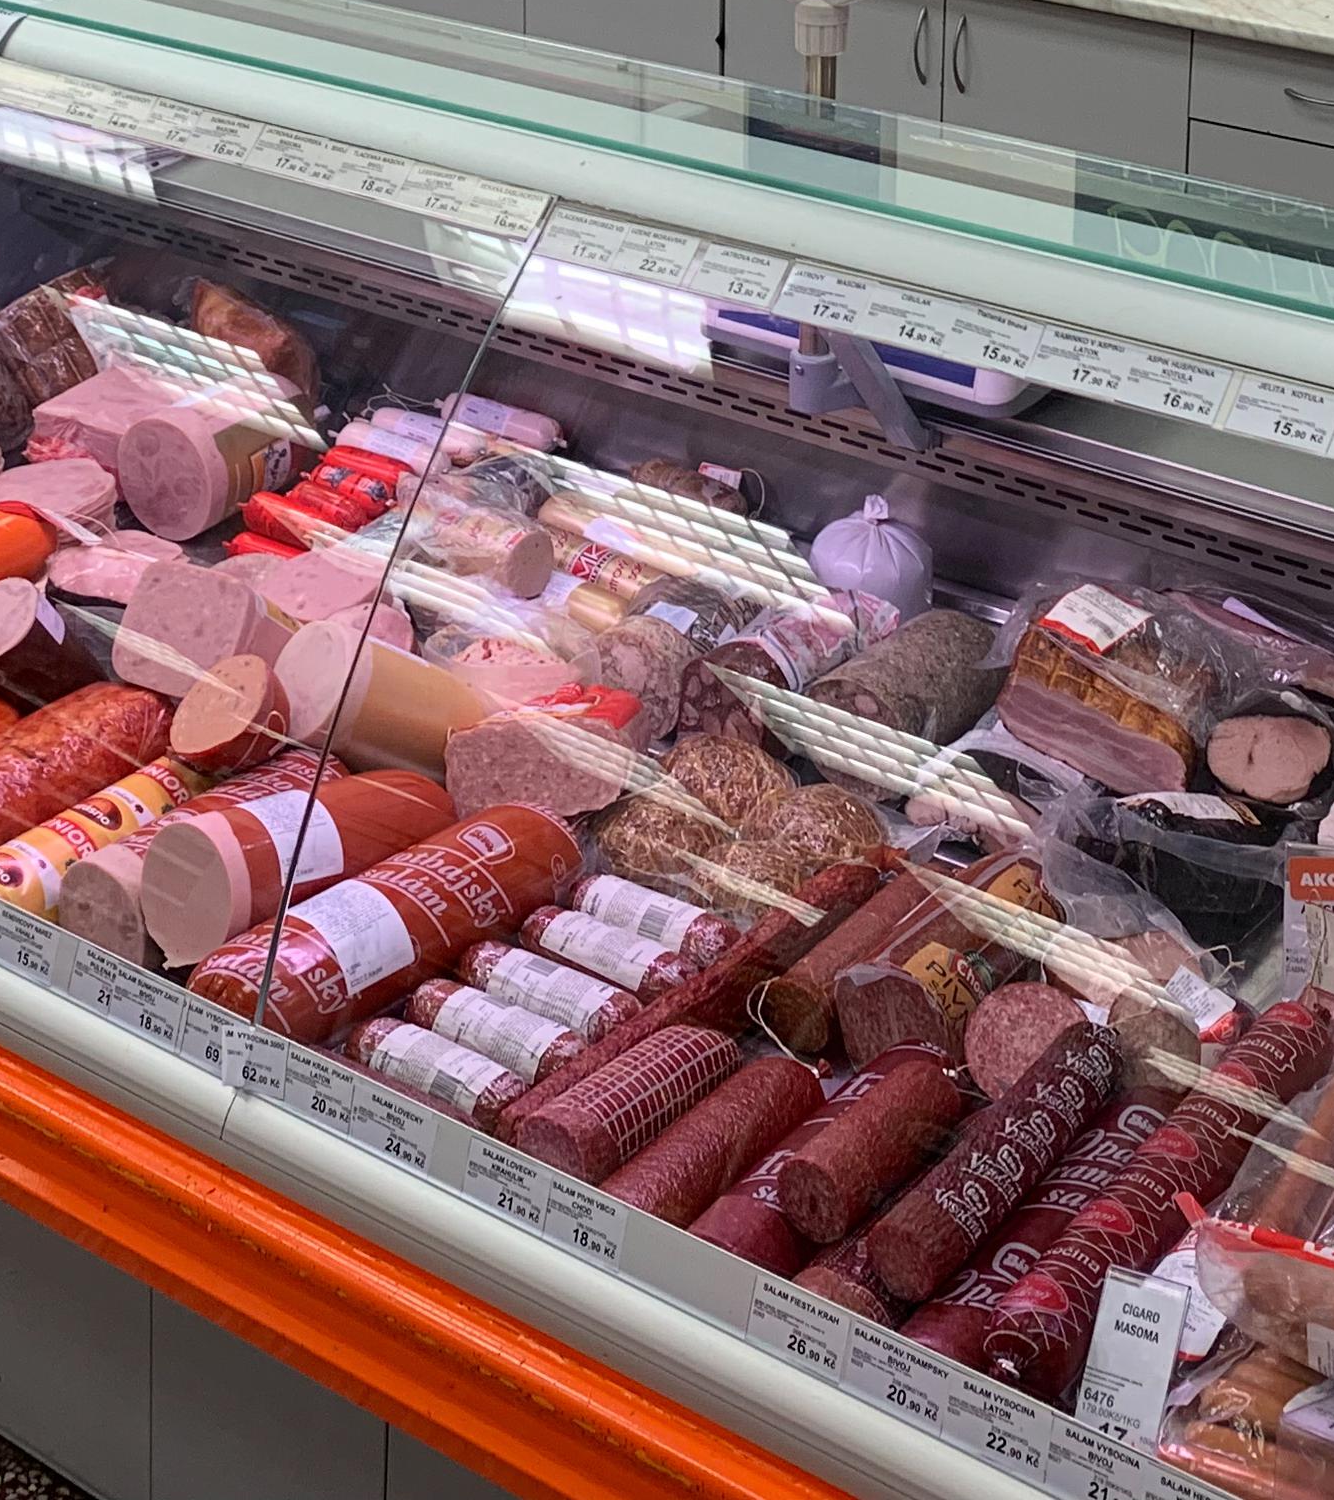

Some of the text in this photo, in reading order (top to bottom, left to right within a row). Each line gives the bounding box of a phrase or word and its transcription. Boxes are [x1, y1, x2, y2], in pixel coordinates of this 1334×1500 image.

[482, 1147, 537, 1179] SALAM LOVECKY
[497, 1192, 526, 1217] 21,90
[572, 1228, 601, 1253] 18,90
[762, 1282, 788, 1302] SALAM
[789, 1293, 817, 1316] FIESTA
[1122, 1300, 1162, 1327] CIGARO
[854, 1327, 881, 1350] SALAM
[1114, 1319, 1160, 1346] MASOMA
[786, 1334, 821, 1364] 26,90
[886, 1384, 921, 1416] 20,90
[963, 1380, 1036, 1420] SALAM VYSOCINA
[983, 1400, 1012, 1421] LATON
[1083, 1387, 1115, 1407] 6476
[985, 1432, 1023, 1460] 22,90
[1065, 1428, 1140, 1470] SALAM VYSOCINA
[1088, 1451, 1114, 1469] BIVOJ
